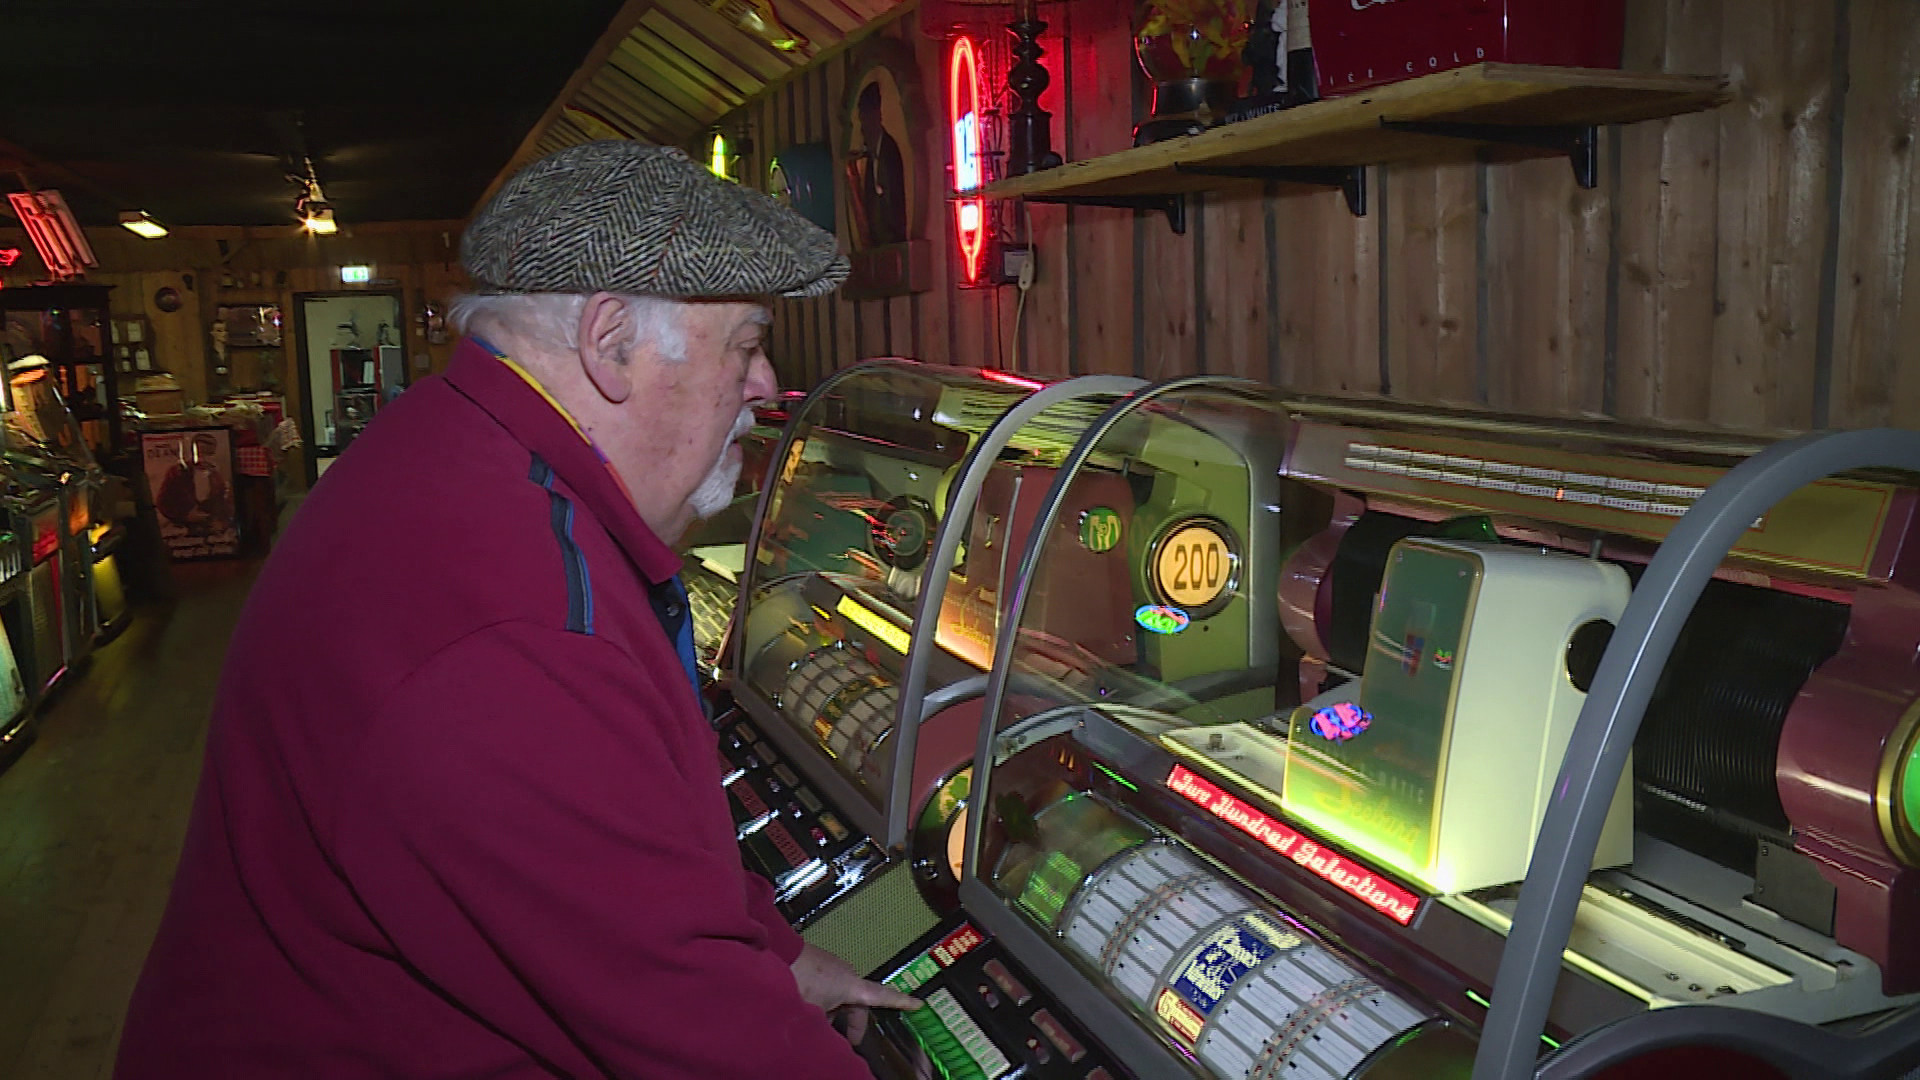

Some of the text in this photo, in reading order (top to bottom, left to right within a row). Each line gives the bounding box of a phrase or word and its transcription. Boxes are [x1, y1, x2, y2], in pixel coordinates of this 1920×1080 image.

[1329, 46, 1485, 87] ICE COLD
[1173, 542, 1220, 591] 200
[1172, 772, 1412, 919] Two Hundred Selections
